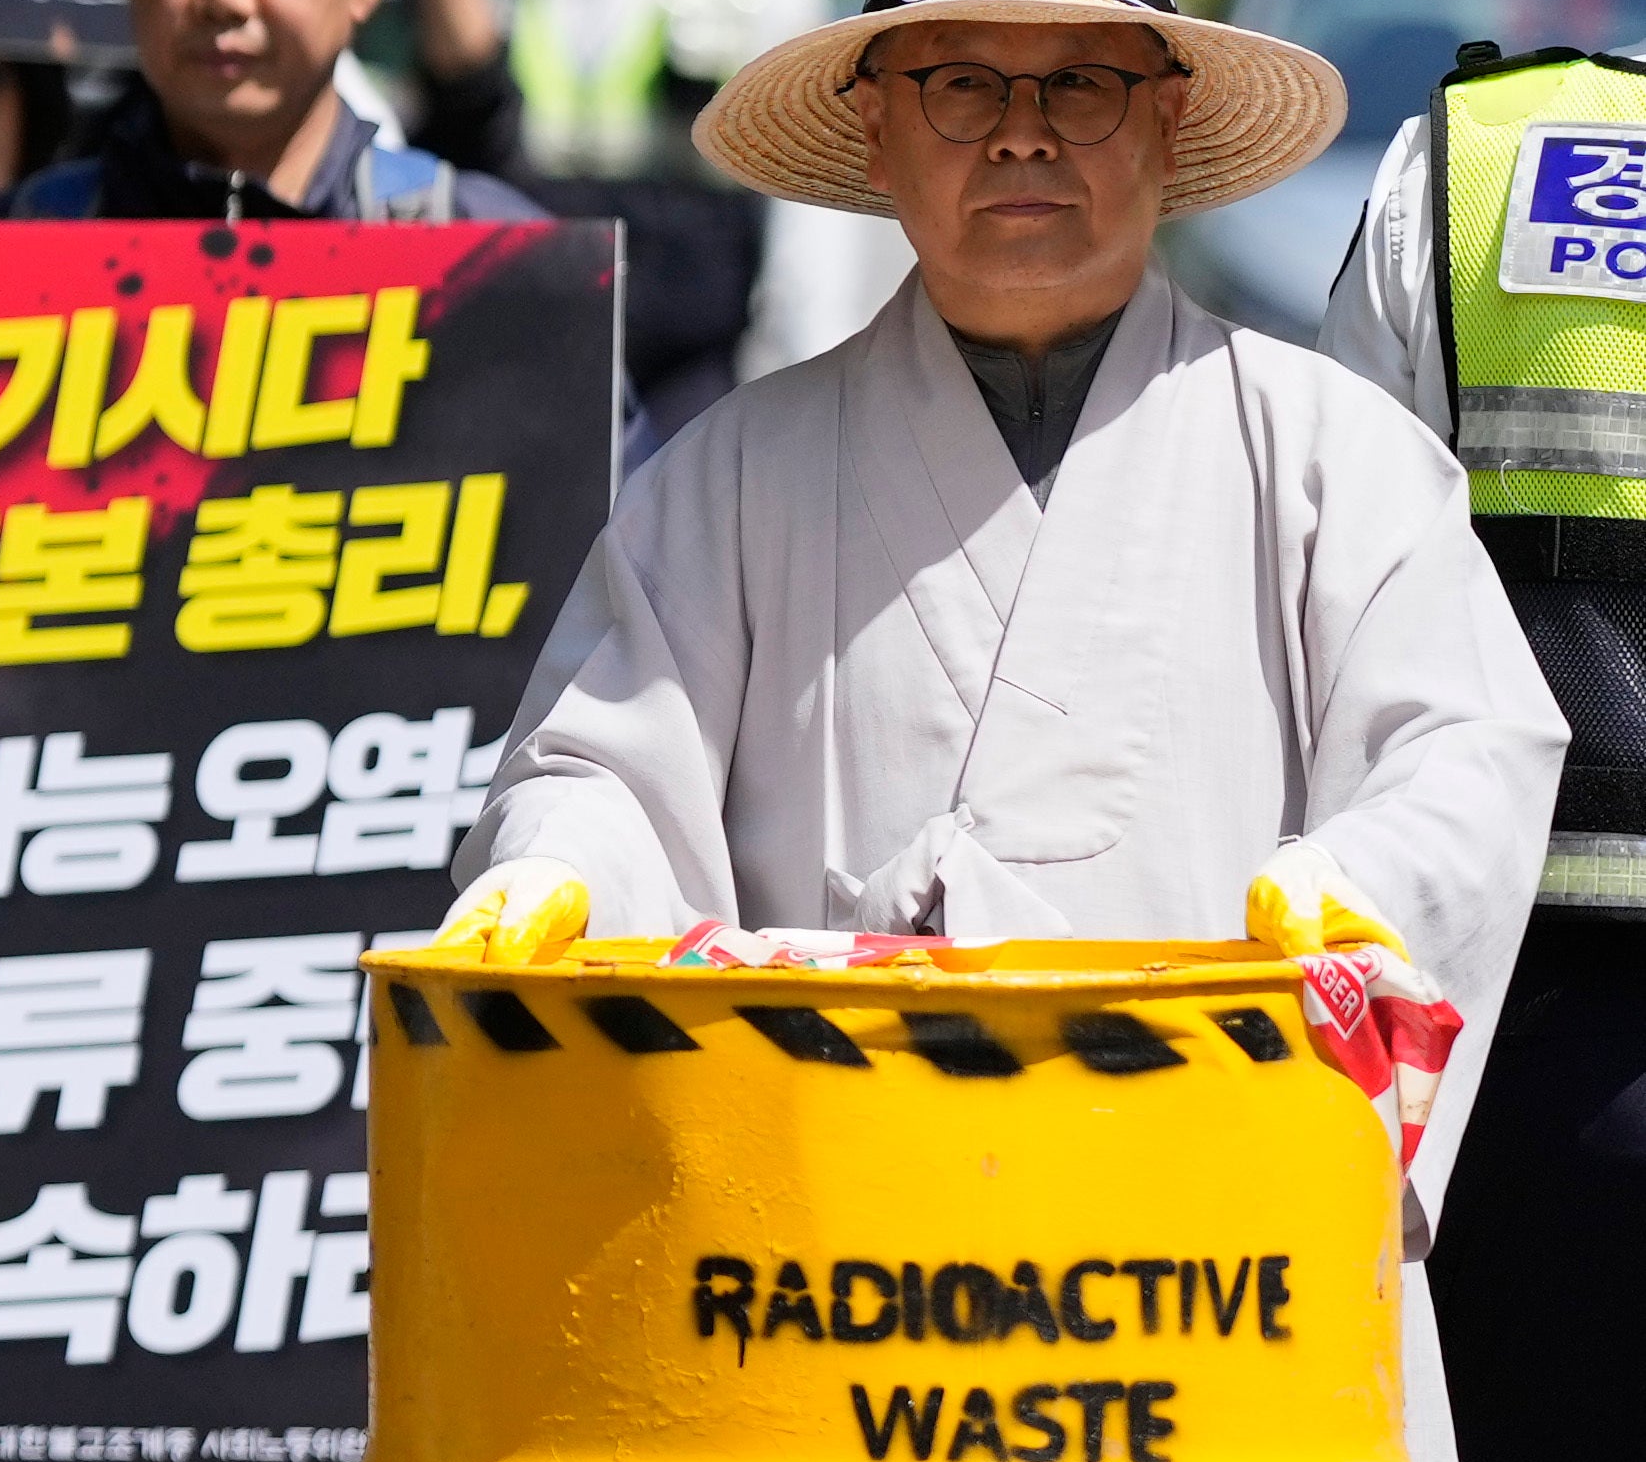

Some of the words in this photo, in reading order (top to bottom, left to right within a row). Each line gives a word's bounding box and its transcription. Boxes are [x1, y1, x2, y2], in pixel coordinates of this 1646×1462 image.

[174, 472, 529, 654] 총리,
[176, 927, 430, 1121] 중
[689, 1253, 1292, 1363] RADIOACTIVE
